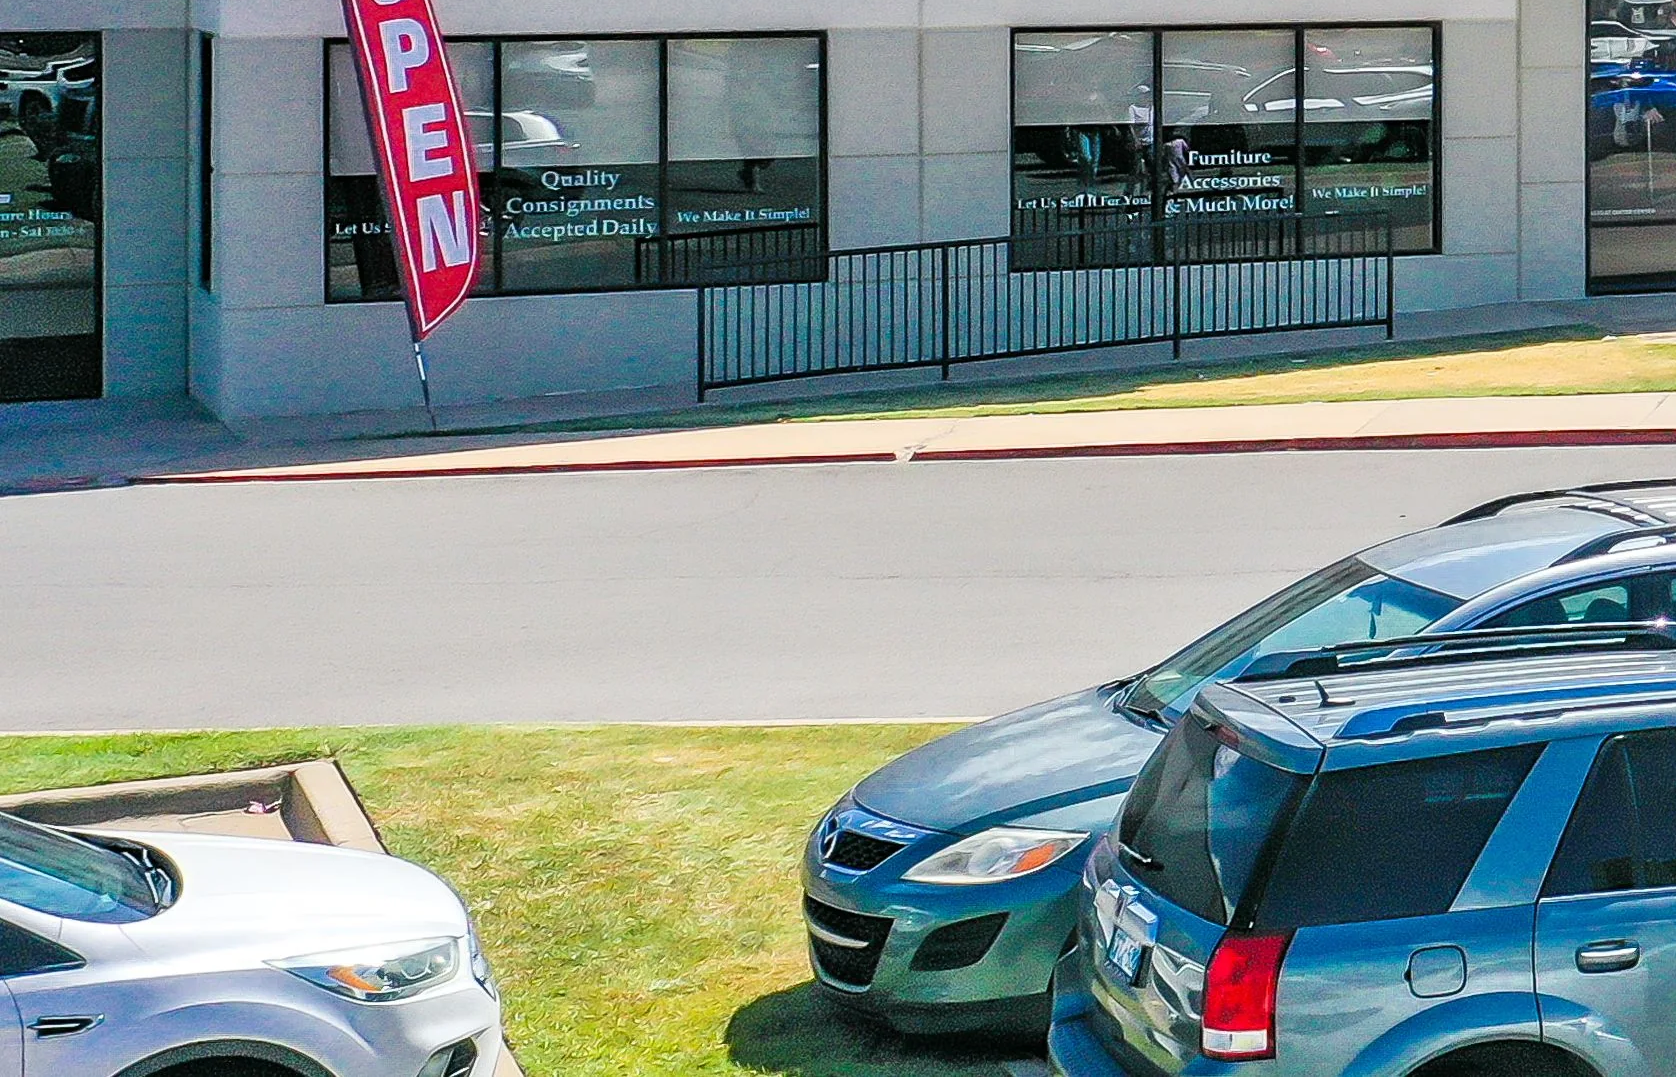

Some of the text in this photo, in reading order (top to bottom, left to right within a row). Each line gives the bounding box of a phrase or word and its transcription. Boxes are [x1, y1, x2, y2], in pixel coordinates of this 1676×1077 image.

[1188, 149, 1272, 166] Furniture
[541, 170, 621, 191] Quality
[1178, 172, 1280, 189] Accessories
[1312, 188, 1332, 199] We
[1335, 187, 1367, 198] Make
[506, 195, 655, 217] Consignments
[1018, 198, 1037, 209] Let
[1041, 197, 1057, 209] Us
[1185, 196, 1237, 212] Much
[1243, 194, 1295, 211] More!
[677, 211, 700, 223] We
[703, 210, 741, 222] Make
[336, 223, 357, 235] Let
[361, 222, 381, 234] Us
[502, 218, 658, 242] Accepted Daily
